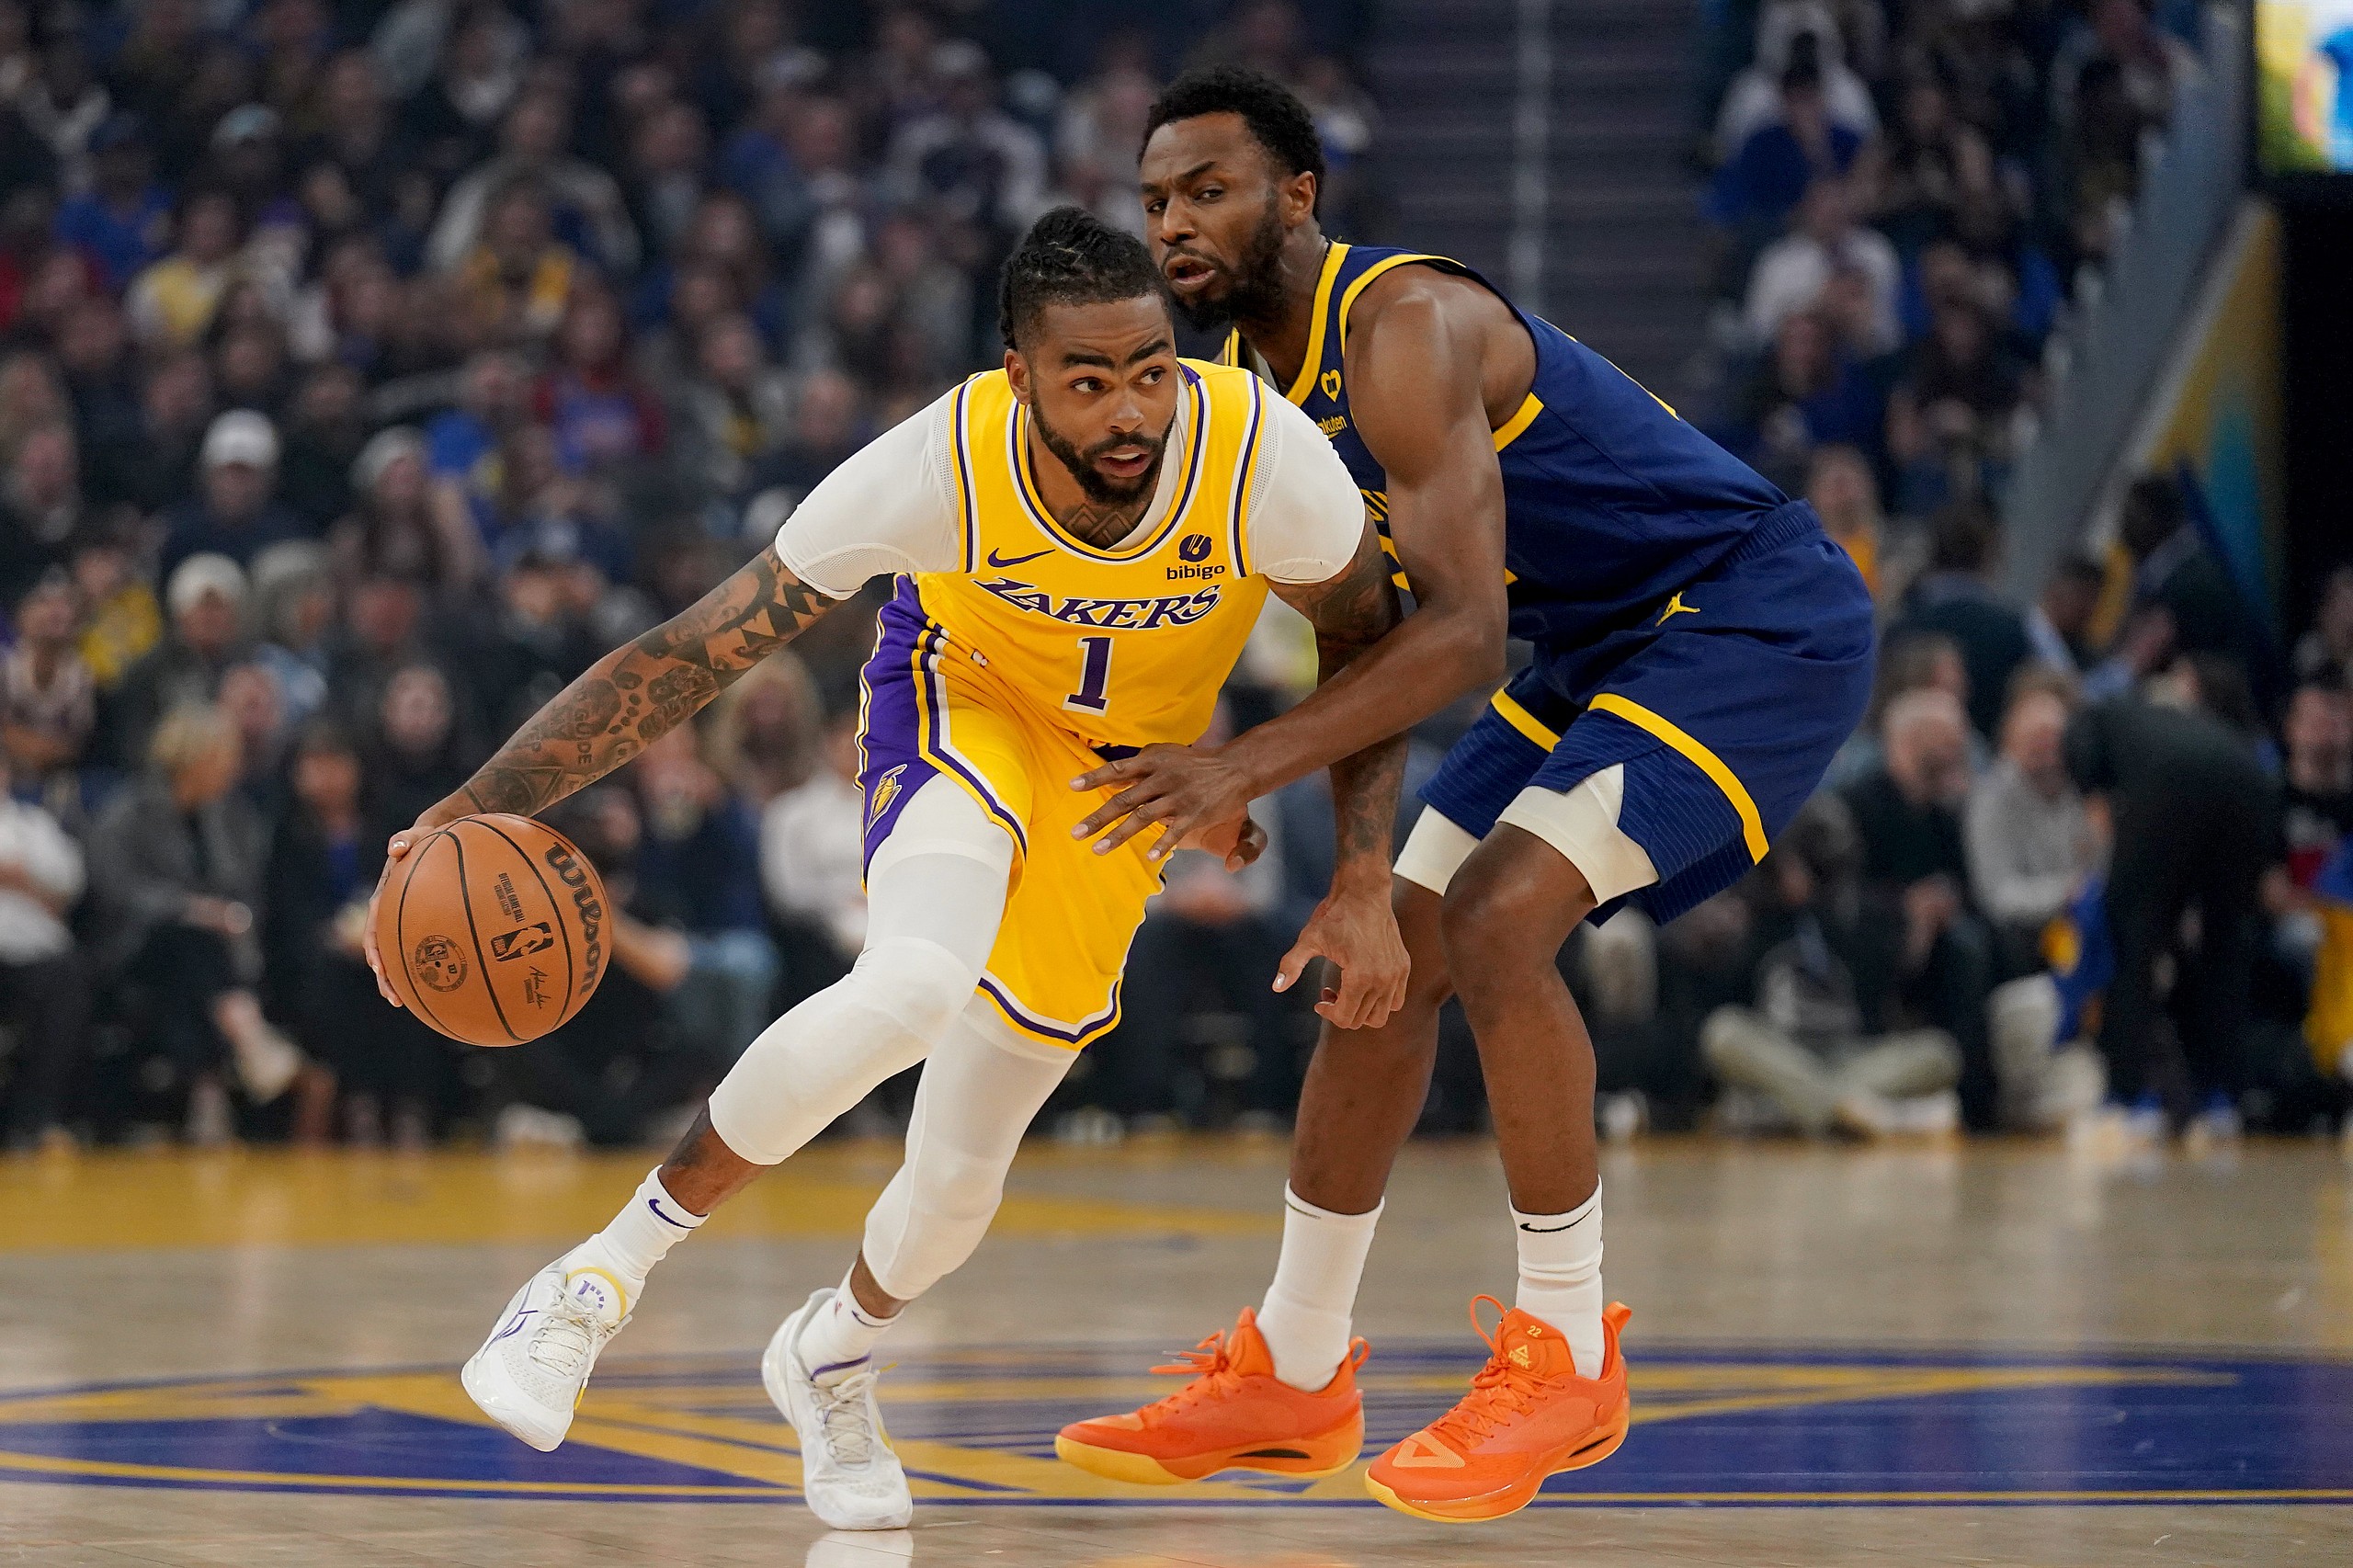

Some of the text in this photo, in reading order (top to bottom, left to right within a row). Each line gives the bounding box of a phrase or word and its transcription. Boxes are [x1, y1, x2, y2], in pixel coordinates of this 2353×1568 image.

[1317, 415, 1347, 435] kuten
[1166, 563, 1225, 580] bibigo
[971, 577, 1222, 630] LAKERS
[1062, 636, 1114, 717] 1
[1527, 1324, 1542, 1337] 22
